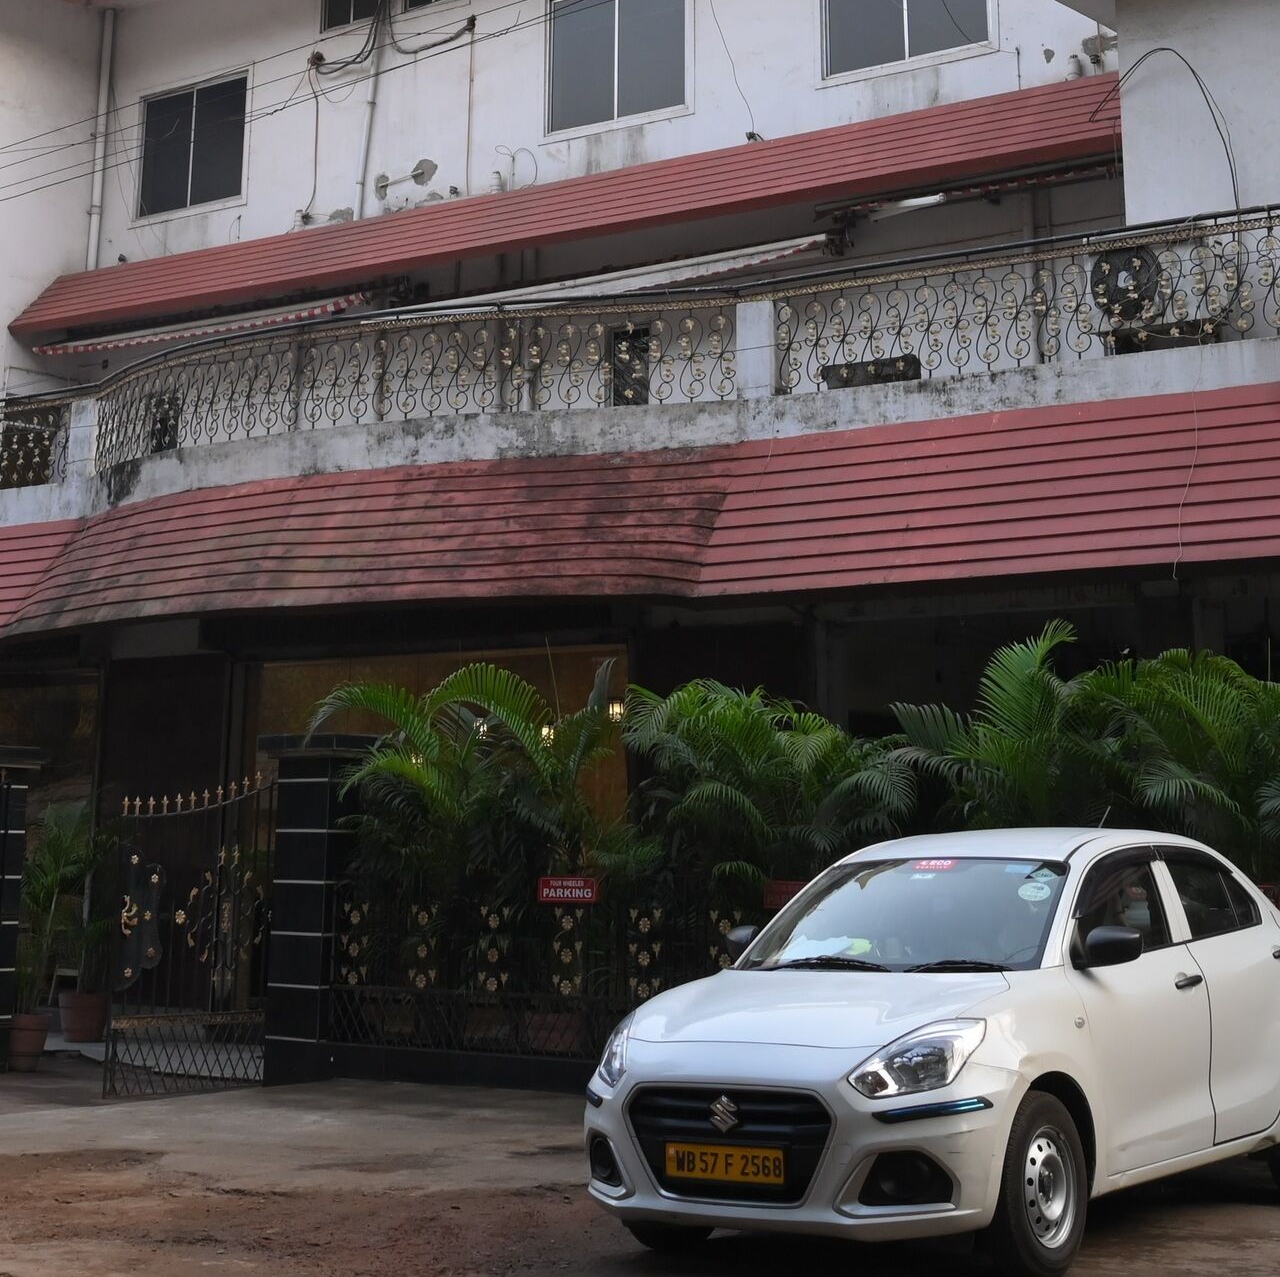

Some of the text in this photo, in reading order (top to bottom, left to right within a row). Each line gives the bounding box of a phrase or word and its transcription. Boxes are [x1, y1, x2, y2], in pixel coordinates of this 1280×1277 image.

[543, 888, 592, 898] PARKING
[675, 1150, 782, 1178] WB 57 F 2568
